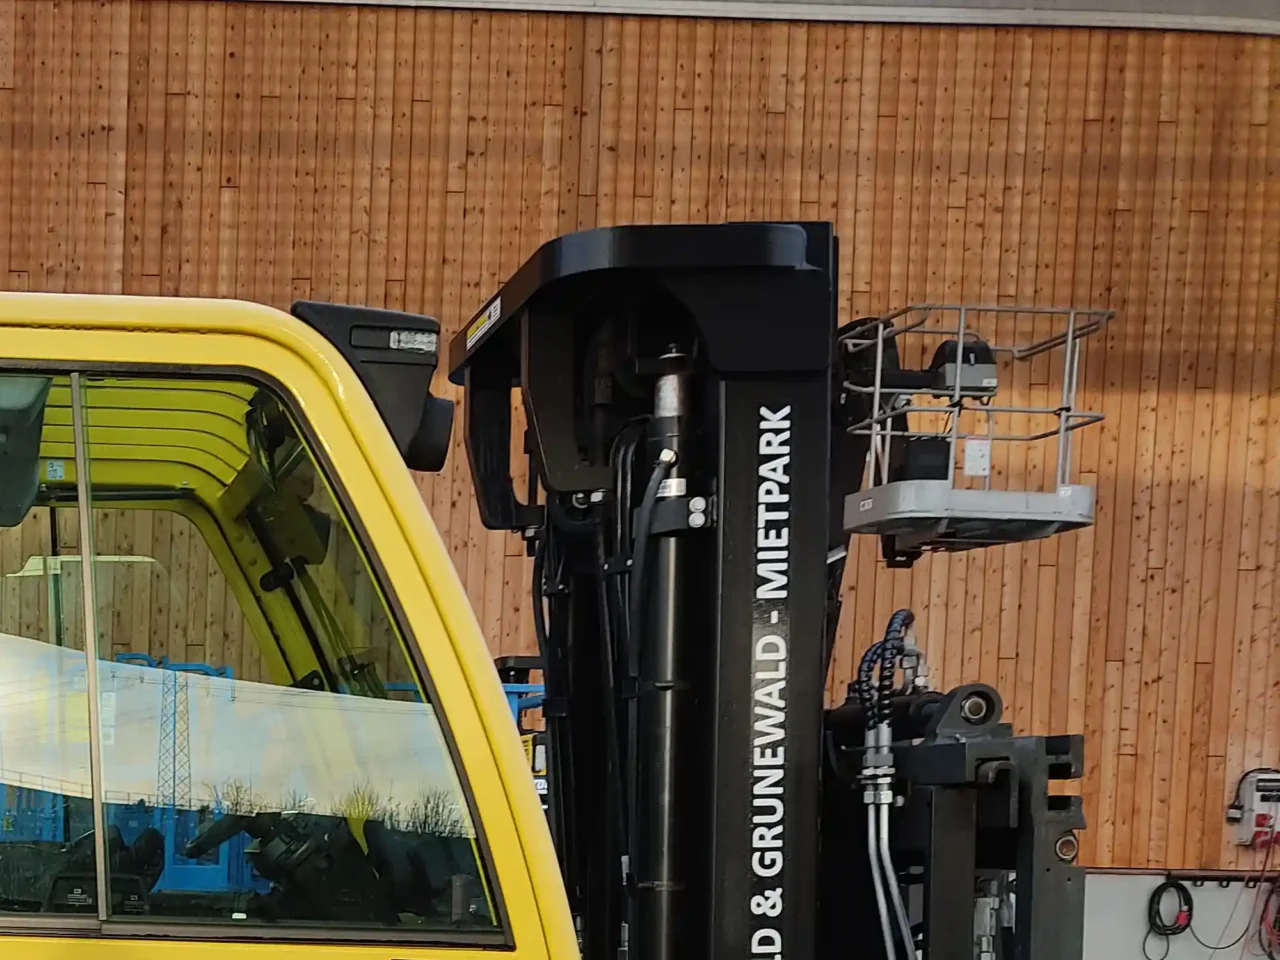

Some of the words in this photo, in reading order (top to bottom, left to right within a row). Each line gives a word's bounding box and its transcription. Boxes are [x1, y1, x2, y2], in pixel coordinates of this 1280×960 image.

[756, 404, 792, 600] MIETPARK
[768, 610, 778, 625] -
[752, 634, 787, 879] GRUNEWALD
[750, 886, 784, 917] &
